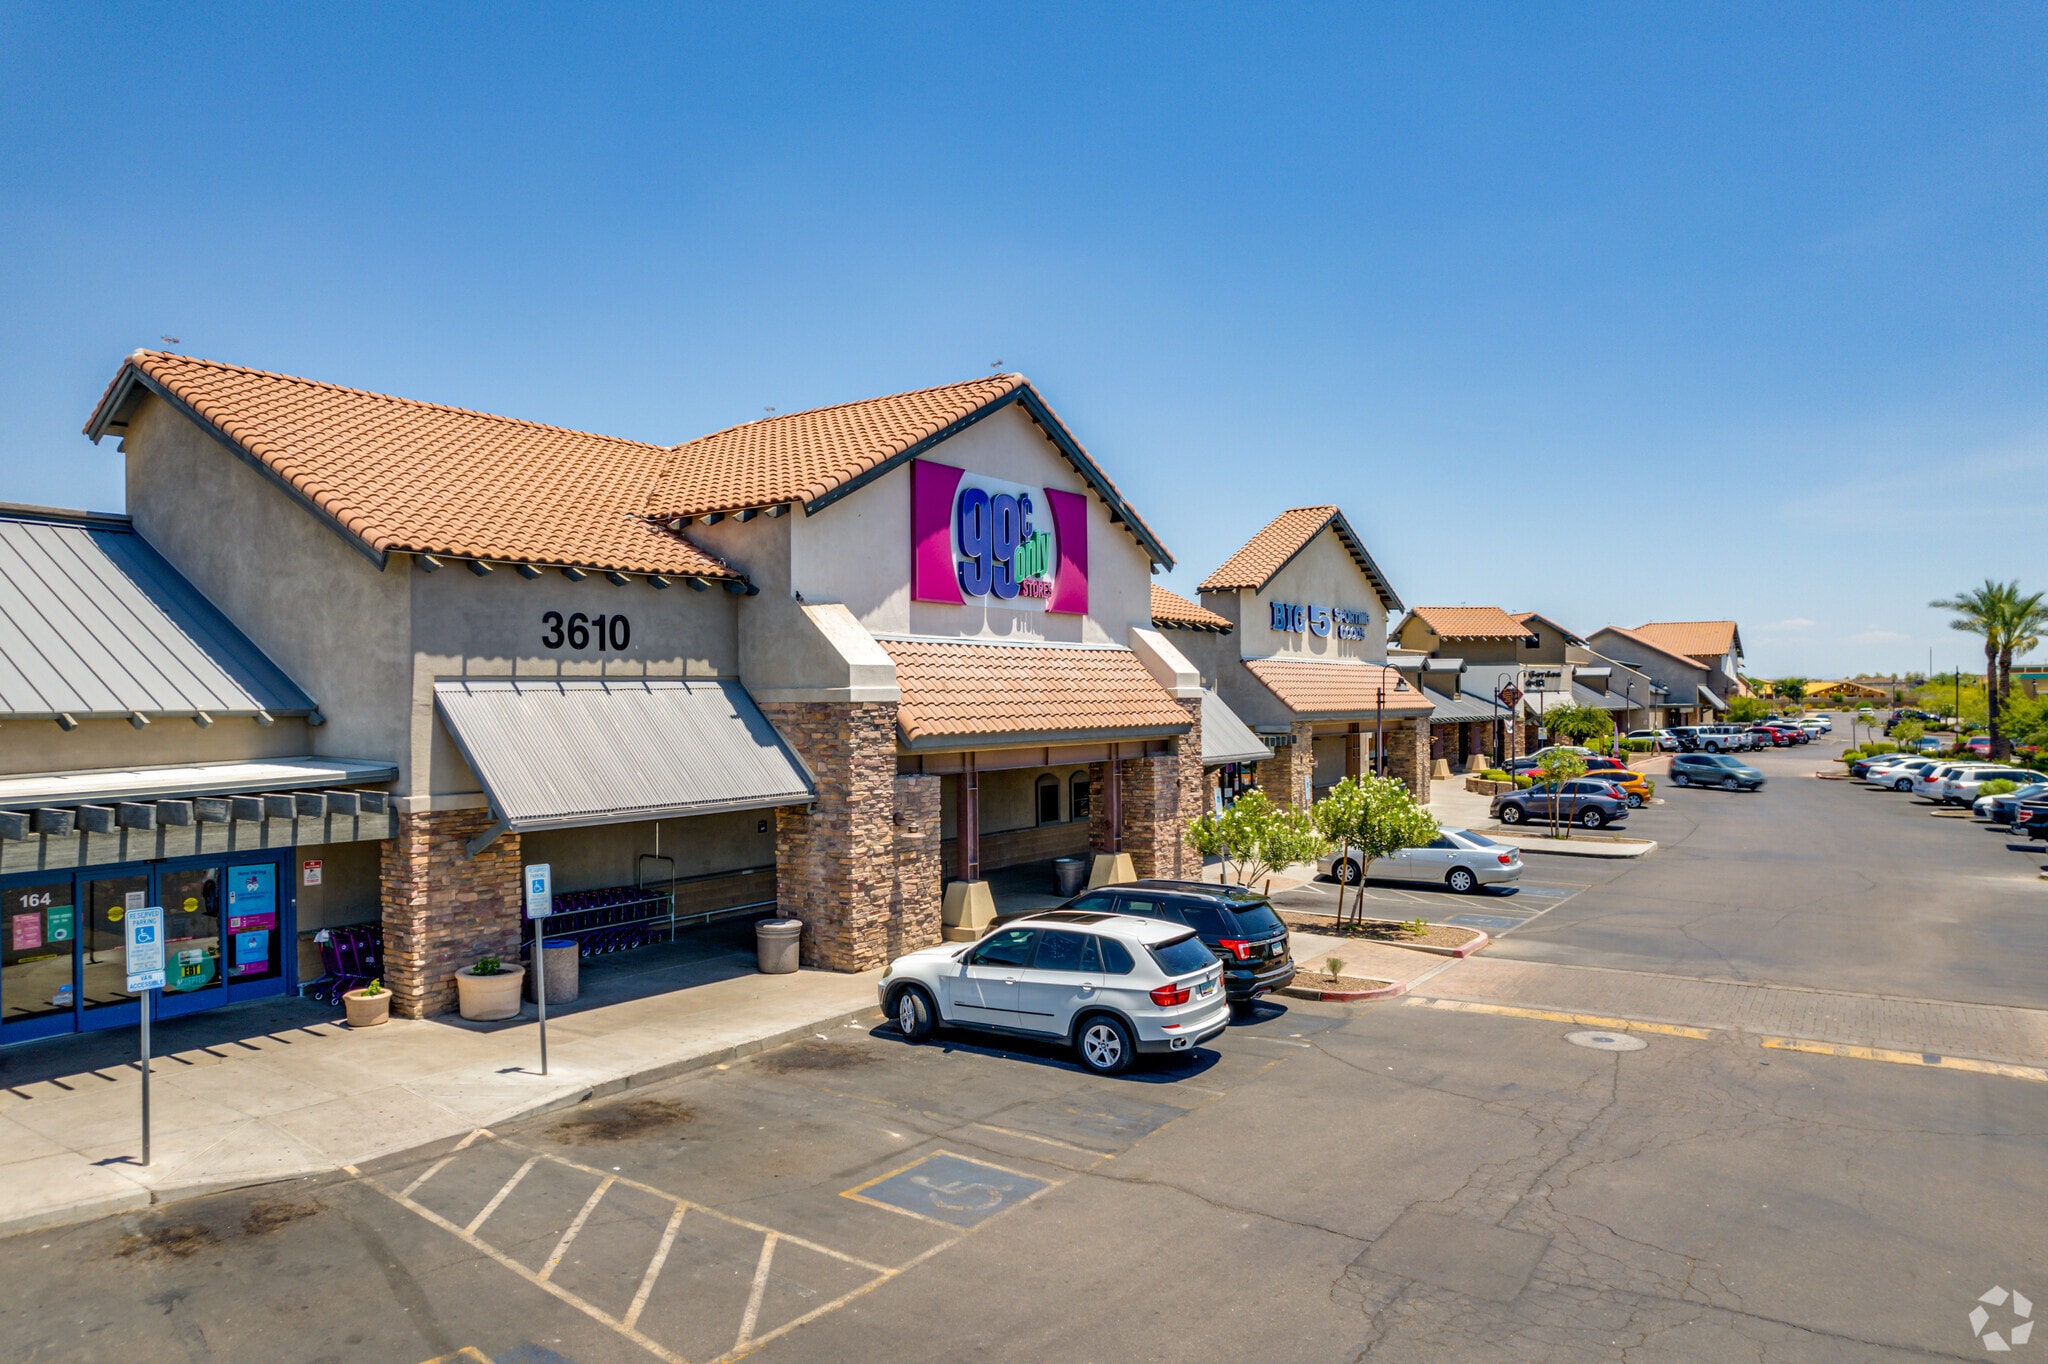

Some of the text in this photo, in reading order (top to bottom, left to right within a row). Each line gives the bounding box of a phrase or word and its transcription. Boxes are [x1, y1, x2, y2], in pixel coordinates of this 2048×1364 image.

[1014, 529, 1051, 584] only
[1020, 579, 1052, 599] STORES
[1270, 602, 1331, 637] BIG 5
[1332, 608, 1370, 625] SPORTING
[542, 611, 630, 651] 3610
[1338, 625, 1366, 641] GOODS
[20, 892, 51, 908] 164
[129, 910, 160, 919] RESERVED
[132, 918, 157, 926] PARKING
[184, 965, 198, 977] EBT
[129, 979, 163, 990] ACCESSIBLE
[176, 975, 206, 987] ACCEPTED
